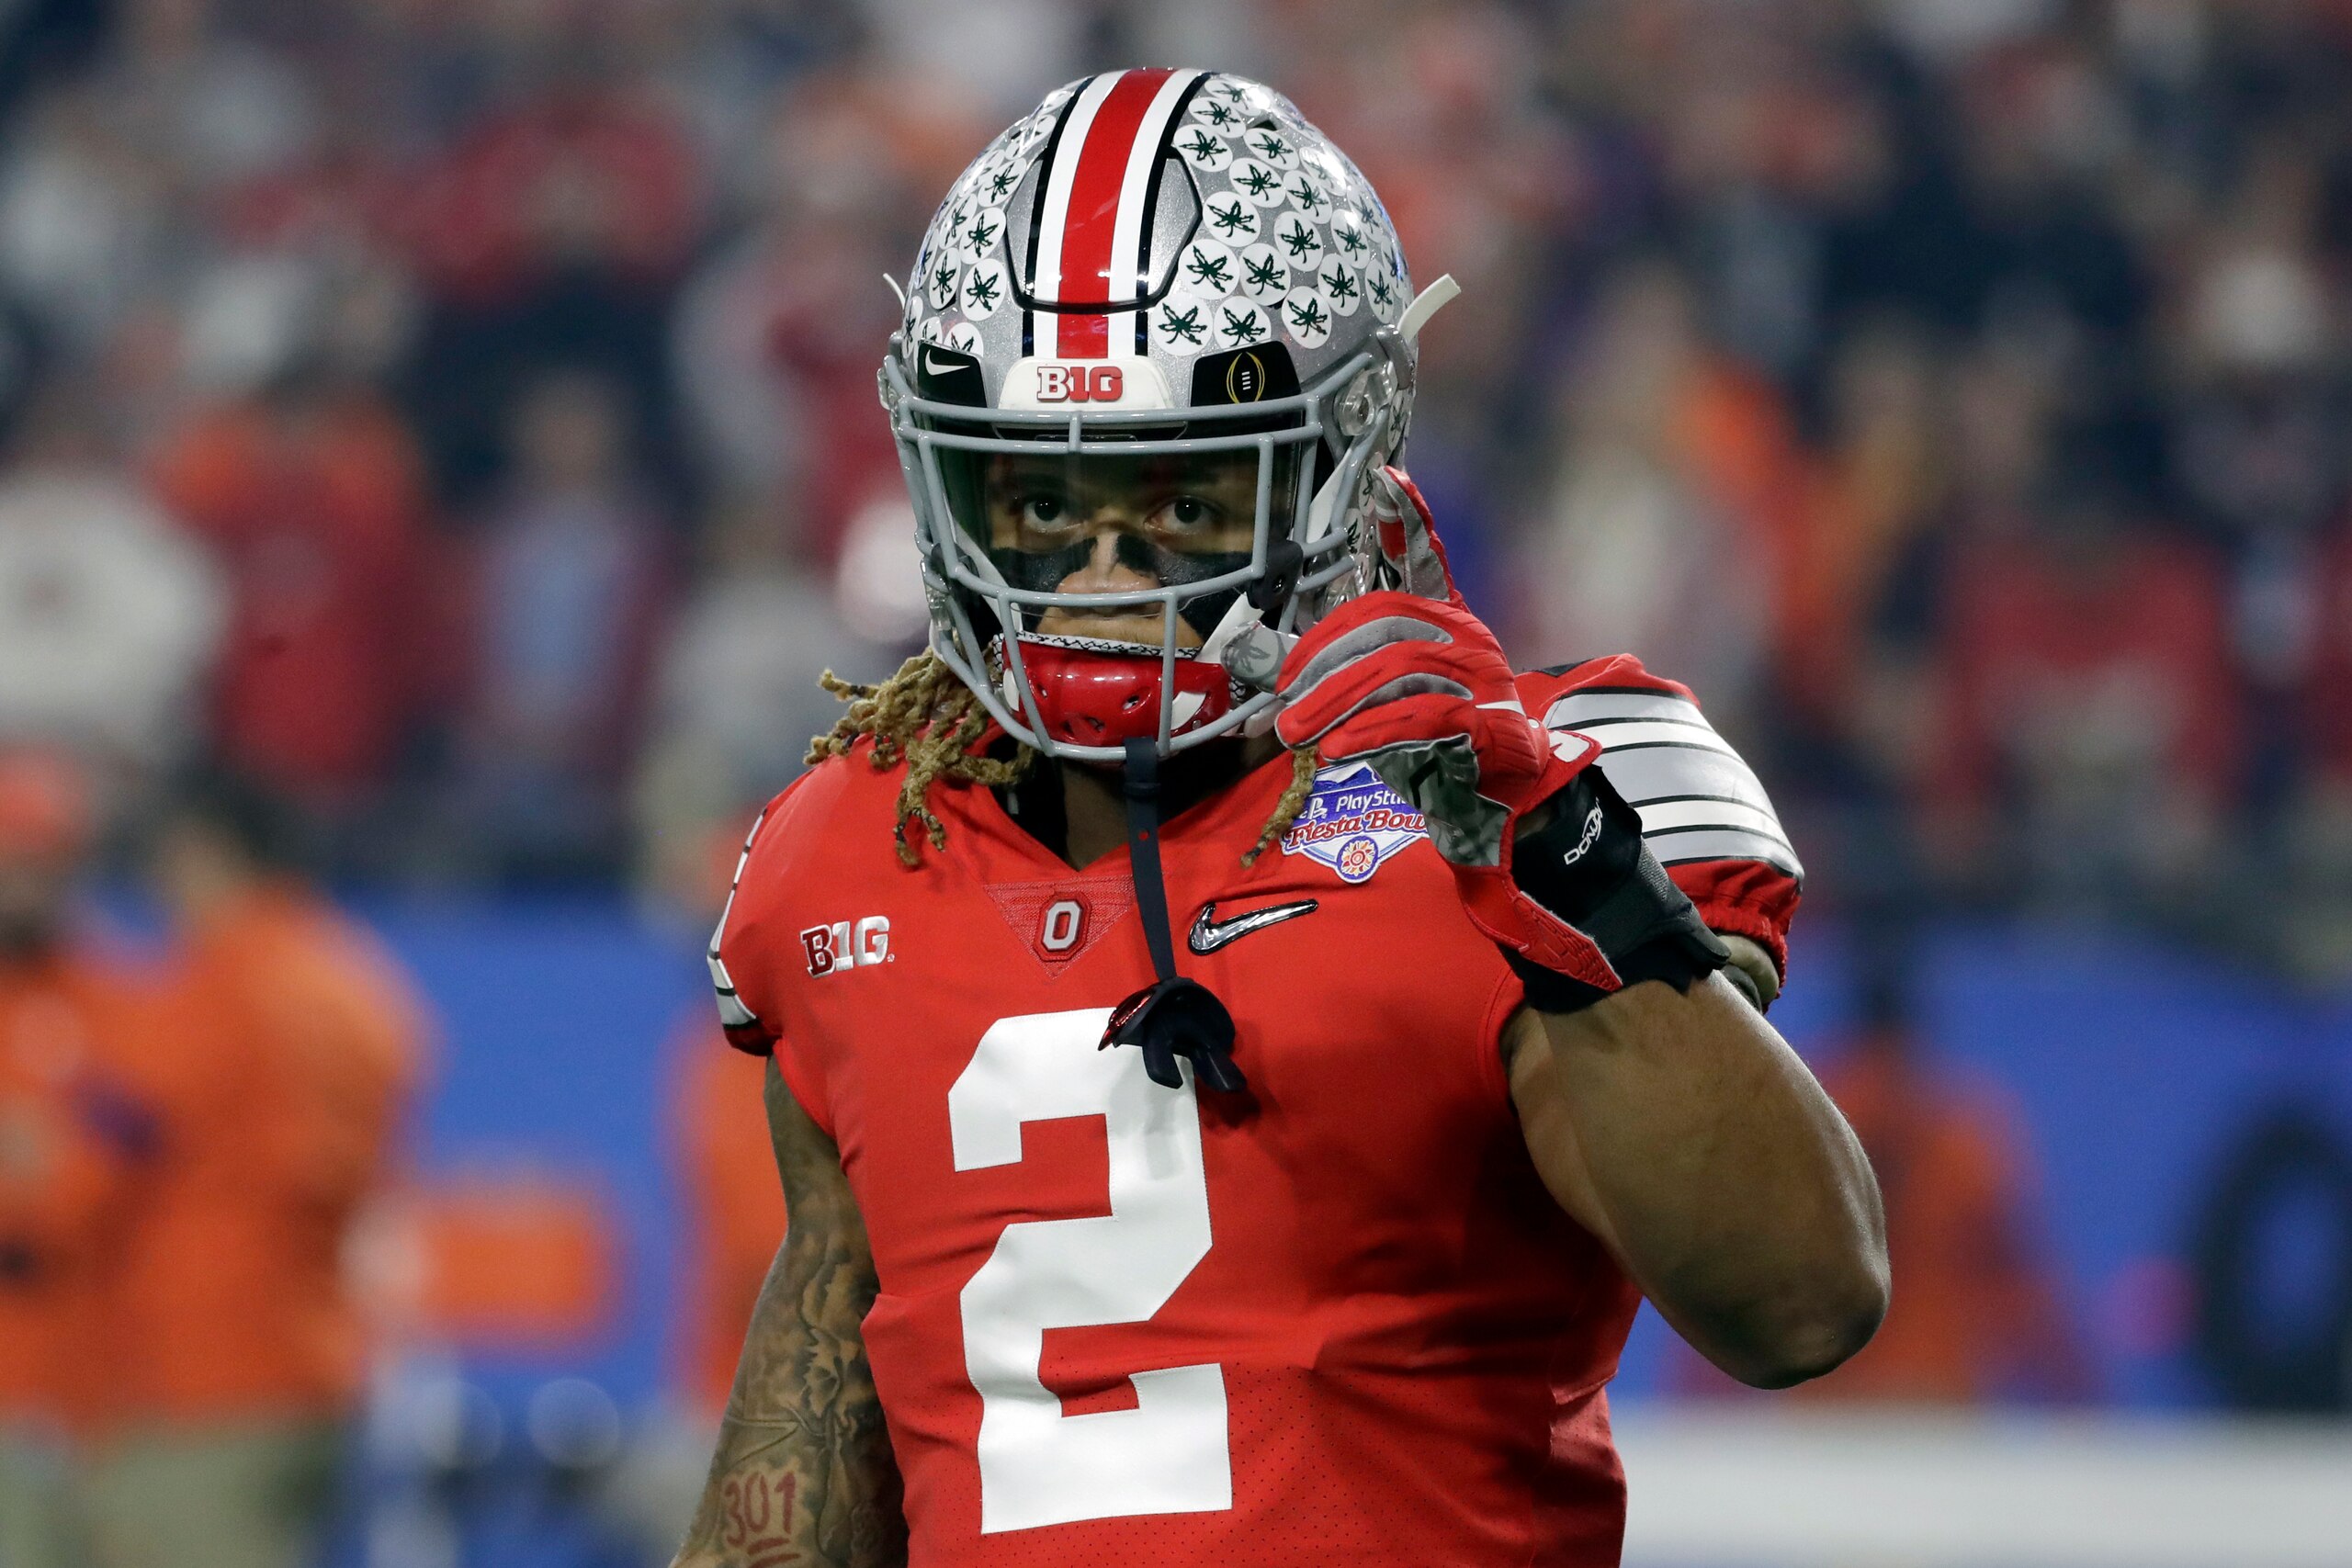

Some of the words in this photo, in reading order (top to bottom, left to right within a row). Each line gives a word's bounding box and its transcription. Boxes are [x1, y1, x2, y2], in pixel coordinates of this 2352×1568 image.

[1284, 815, 1363, 848] Fiesta
[1364, 809, 1427, 830] Bow
[947, 1007, 1233, 1535] 2
[724, 1471, 797, 1547] 301
